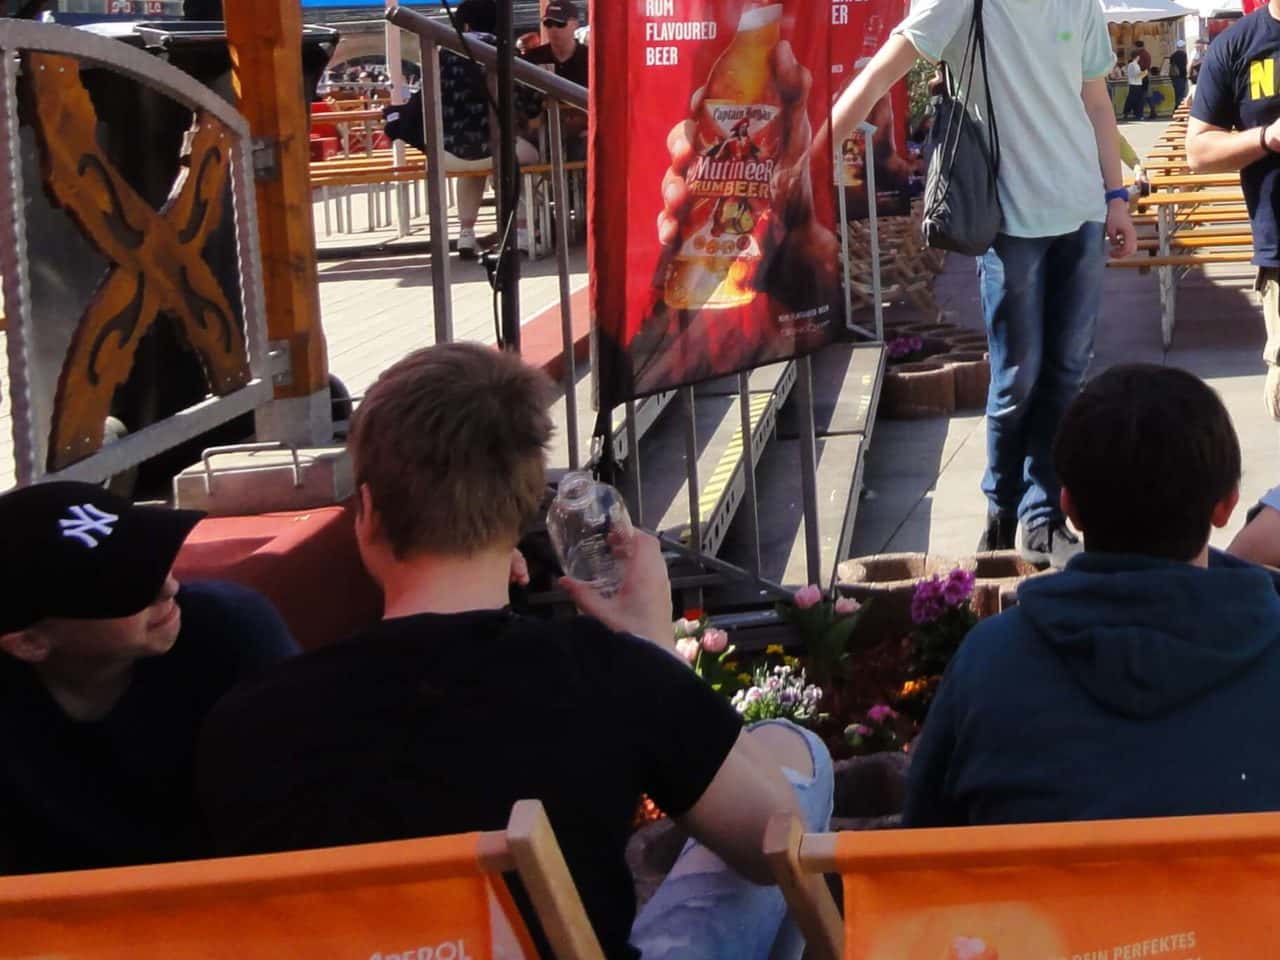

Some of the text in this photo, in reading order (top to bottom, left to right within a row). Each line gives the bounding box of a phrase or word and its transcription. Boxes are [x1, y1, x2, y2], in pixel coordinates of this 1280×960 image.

[646, 20, 717, 41] FLAVOURED
[645, 46, 679, 66] BEER
[1112, 931, 1197, 960] PERFEKTES
